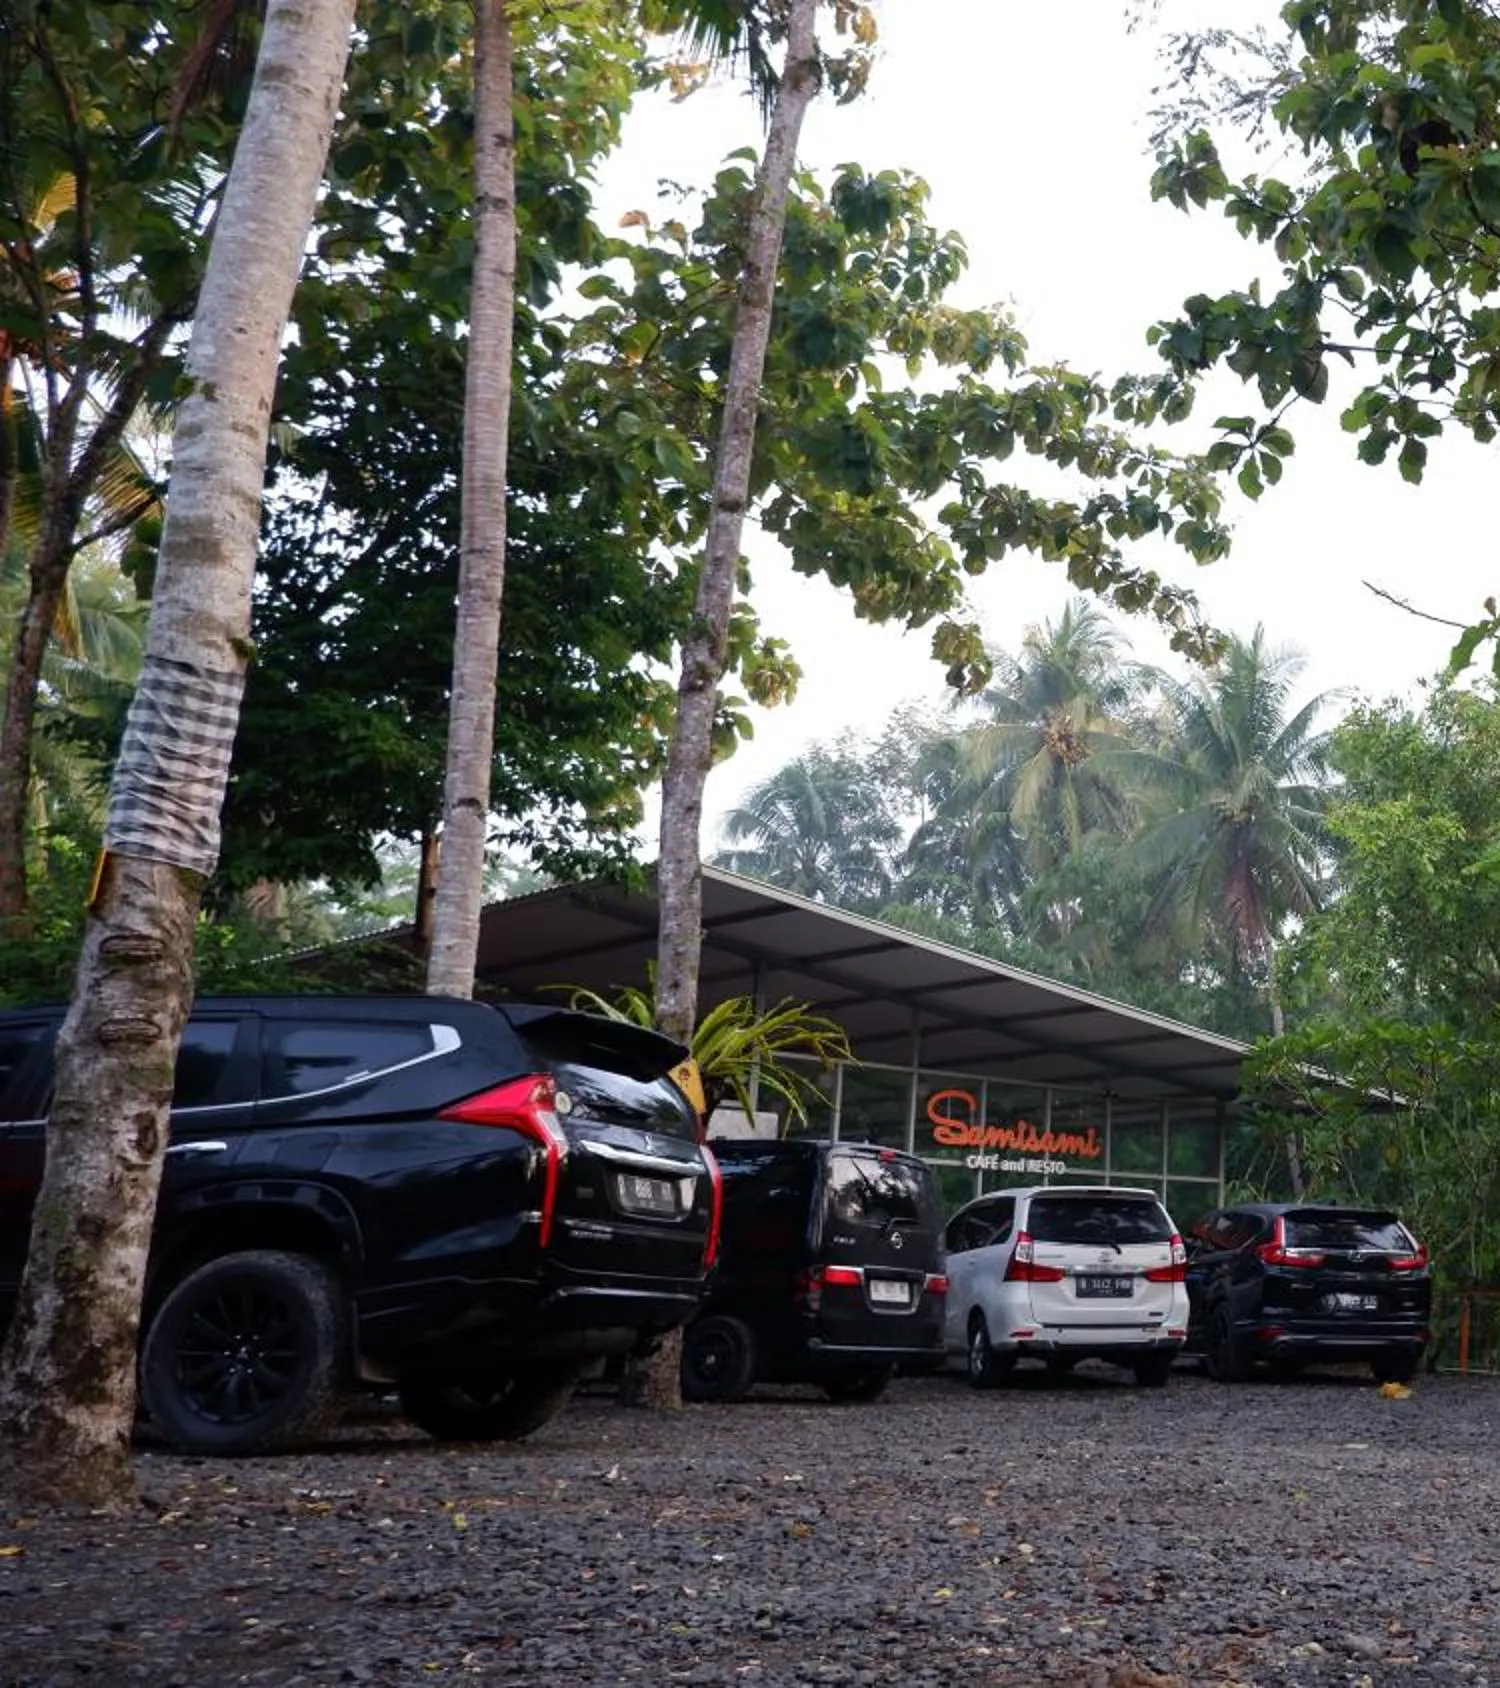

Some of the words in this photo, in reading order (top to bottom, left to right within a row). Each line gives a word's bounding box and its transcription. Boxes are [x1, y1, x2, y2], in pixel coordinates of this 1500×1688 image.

[926, 1088, 1101, 1159] Samisami
[1000, 1158, 1025, 1172] and
[1026, 1159, 1066, 1175] RESTO
